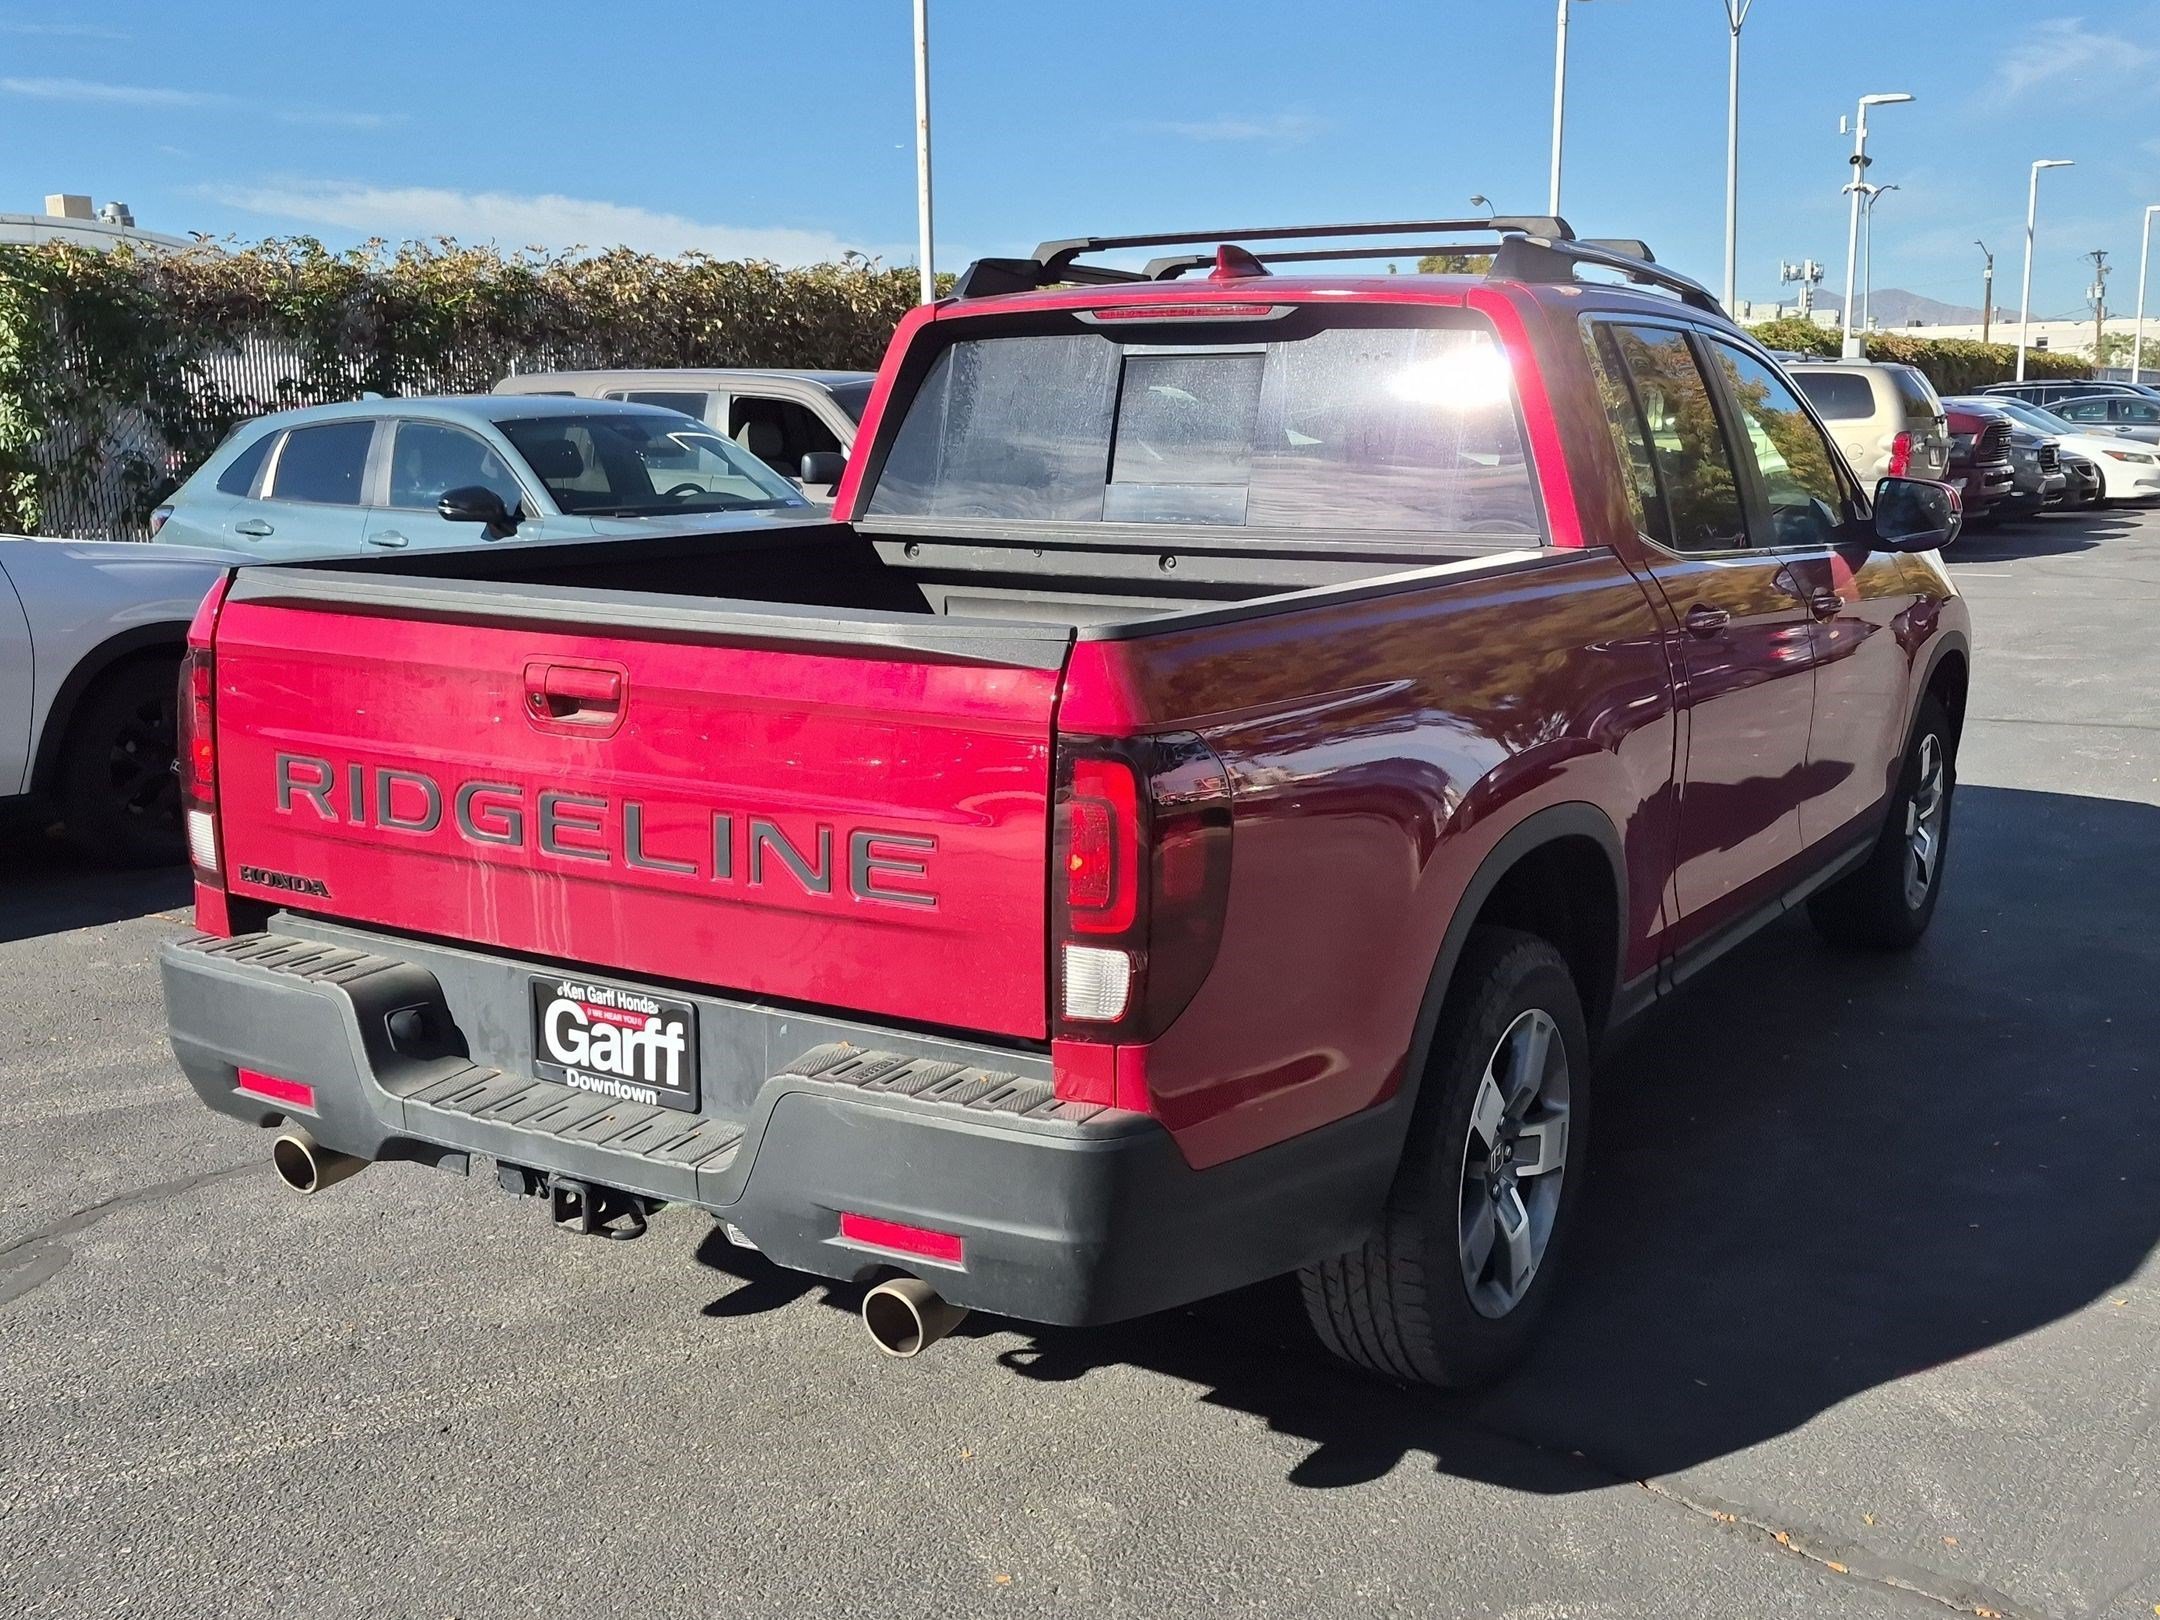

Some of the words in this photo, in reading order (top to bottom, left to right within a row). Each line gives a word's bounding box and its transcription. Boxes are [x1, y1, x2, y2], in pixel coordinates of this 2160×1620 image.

[275, 750, 937, 907] RIDGELINE
[239, 865, 332, 898] HONDA
[562, 981, 585, 1000] Ken
[586, 986, 615, 1007] Garff
[617, 991, 655, 1014] Honda
[592, 1008, 604, 1018] WE
[604, 1011, 622, 1022] HEAR
[545, 998, 685, 1086] Garff
[566, 1068, 657, 1105] Downtown
